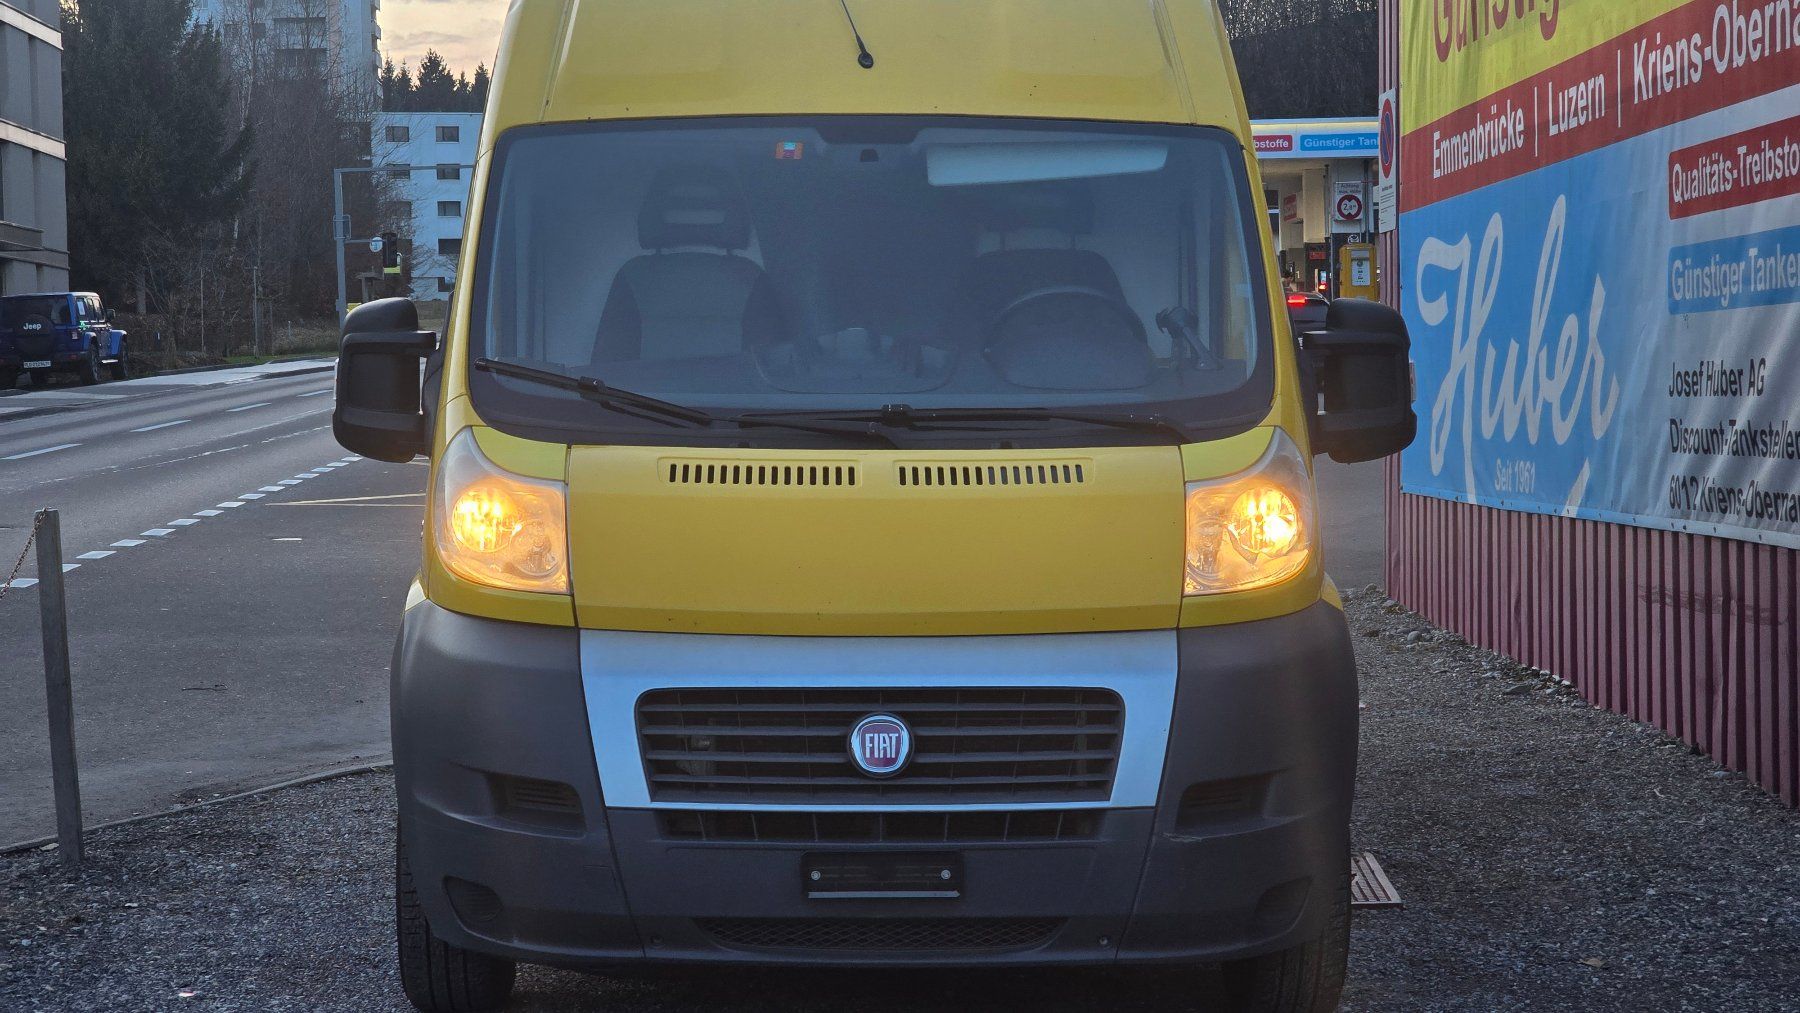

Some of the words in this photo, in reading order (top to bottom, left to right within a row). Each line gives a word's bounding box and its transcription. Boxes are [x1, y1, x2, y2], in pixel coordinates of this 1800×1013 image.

[1304, 138, 1356, 148] Günstiger
[1358, 136, 1379, 147] Tan
[1434, 99, 1525, 179] Emmenbrücke
[1548, 73, 1605, 137] Luzern
[1672, 136, 1800, 205] Qualitäts-Treibsto
[1672, 254, 1746, 308] Günstiger
[1416, 194, 1620, 504] Huber
[1669, 361, 1704, 398] Josef
[1705, 360, 1744, 397] Huber
[1748, 357, 1766, 397] AG
[1494, 458, 1512, 493] Seit
[1514, 459, 1536, 495] 1961
[1669, 475, 1699, 511] 6012
[1700, 476, 1800, 523] Kriens-Oberna
[865, 733, 899, 759] FIAT
